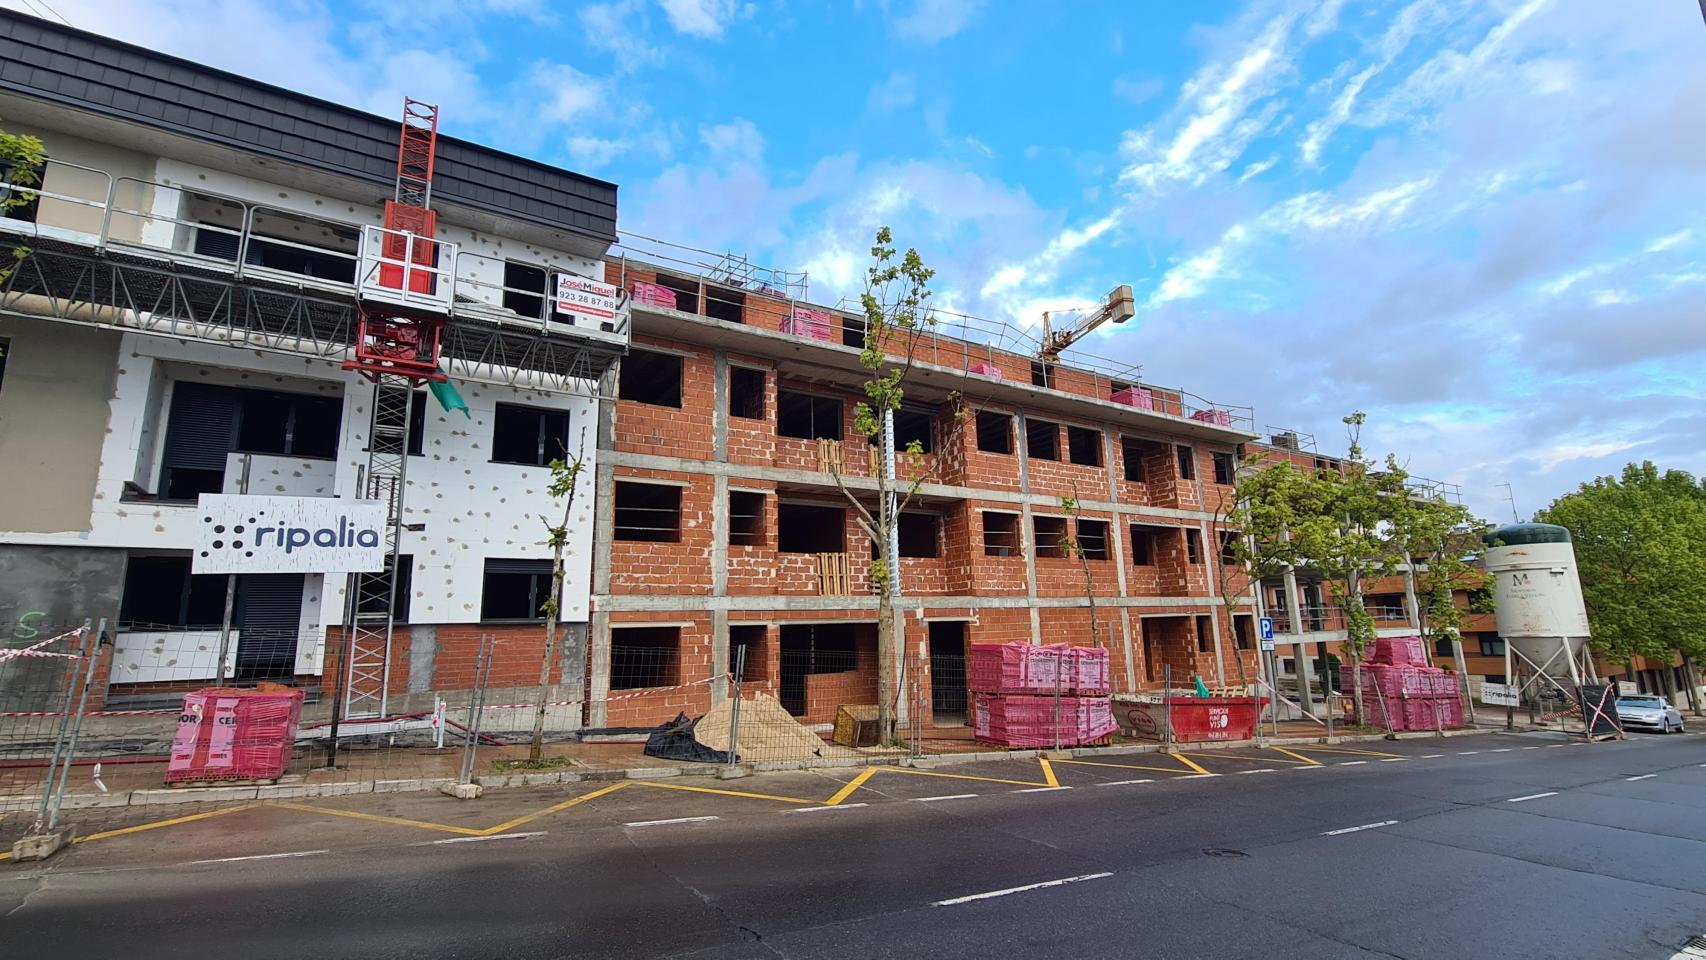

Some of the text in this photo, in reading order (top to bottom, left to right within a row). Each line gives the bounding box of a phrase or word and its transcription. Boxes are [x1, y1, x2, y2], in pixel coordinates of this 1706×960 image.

[560, 290, 614, 309] 923 28 87 88
[255, 515, 379, 554] ripalia
[1261, 620, 1270, 638] P
